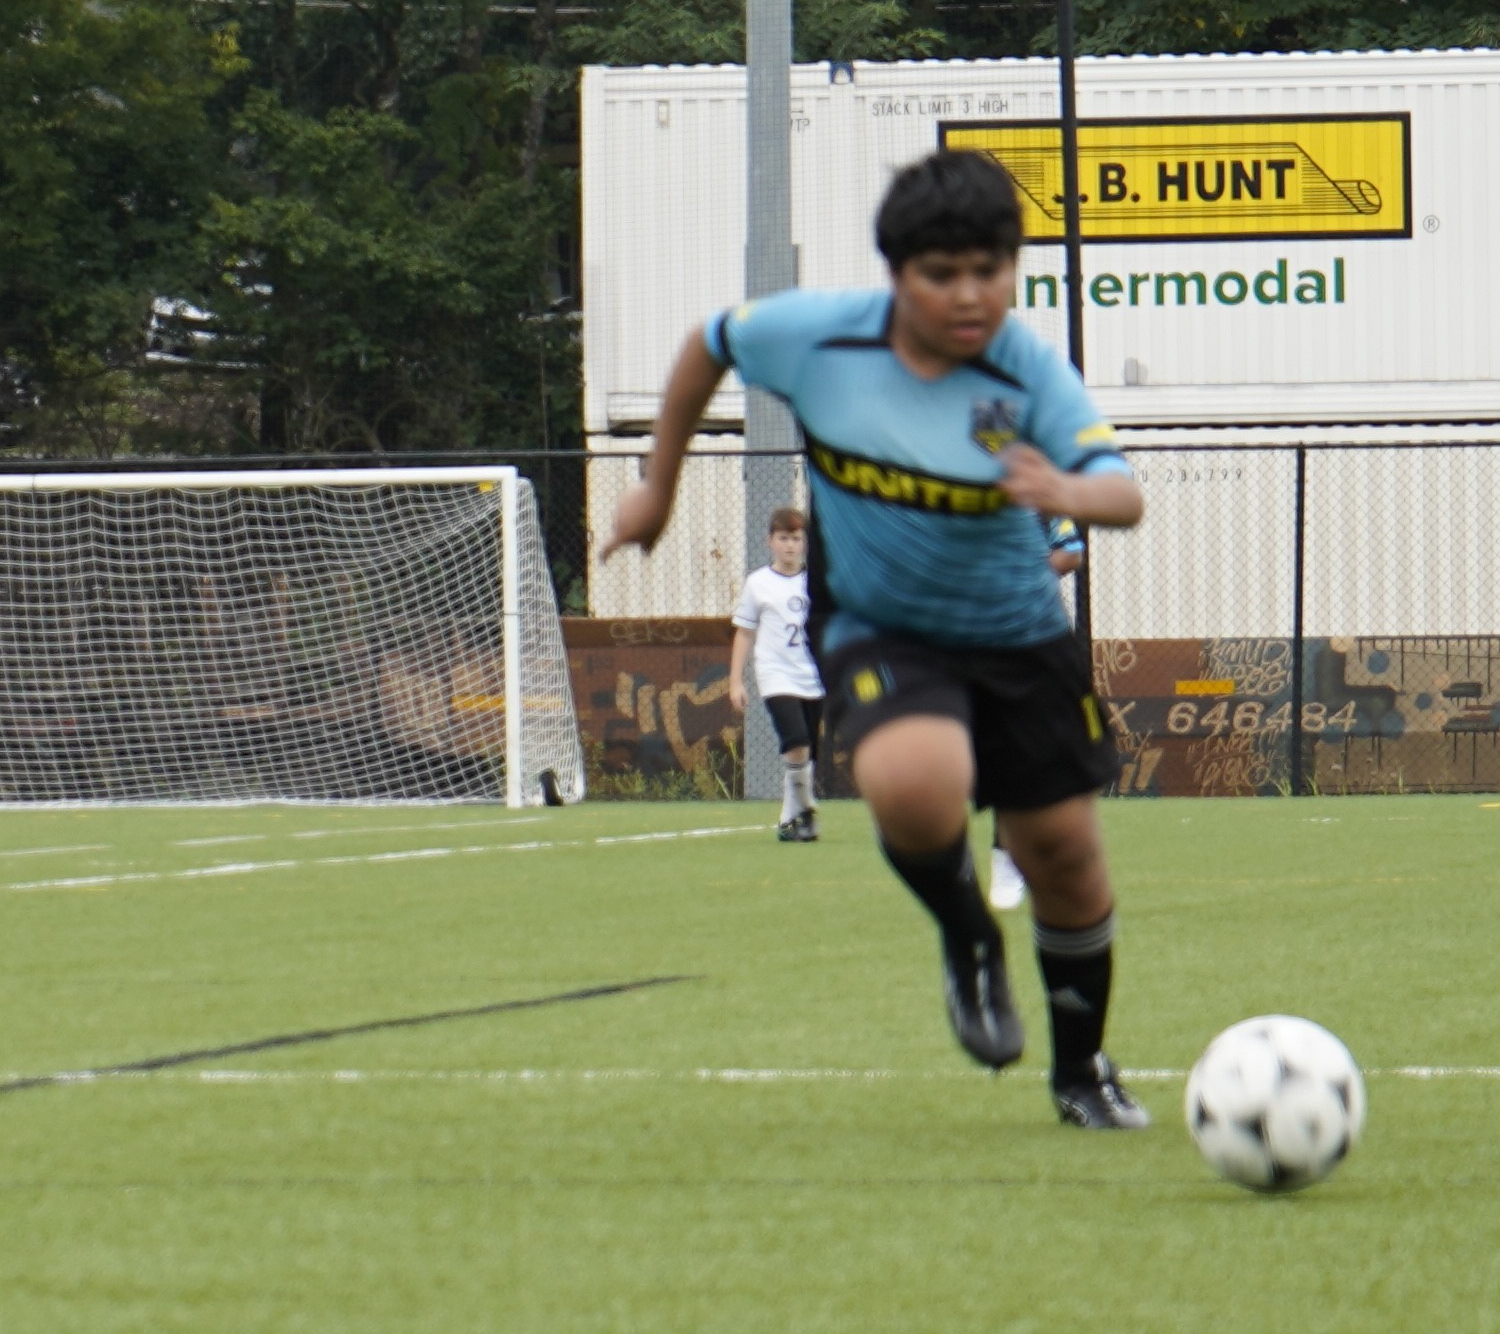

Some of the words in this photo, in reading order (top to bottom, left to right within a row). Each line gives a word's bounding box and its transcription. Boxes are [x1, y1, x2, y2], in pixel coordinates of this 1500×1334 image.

[791, 118, 810, 132] TP
[872, 101, 910, 116] STACK
[919, 101, 952, 115] LIMIT
[963, 101, 970, 114] 3
[978, 100, 1009, 113] HIGH
[1157, 158, 1296, 202] HUNT
[1010, 257, 1345, 308] nermodal
[1167, 700, 1358, 735] 646484
